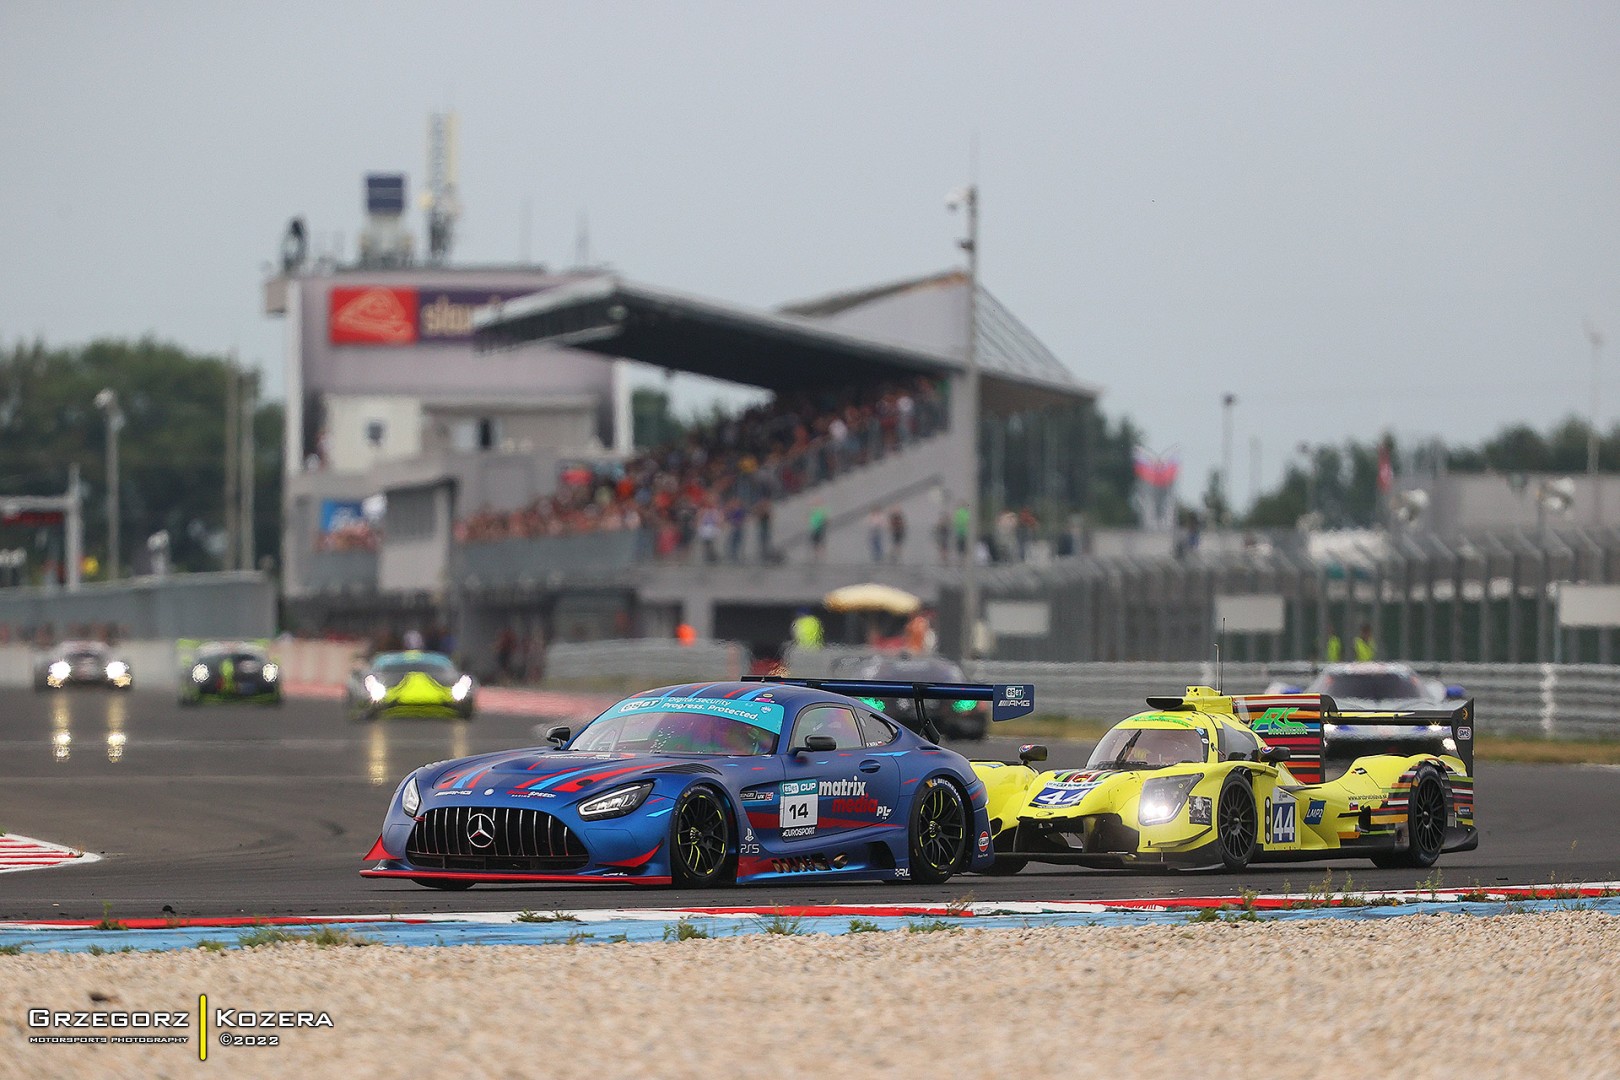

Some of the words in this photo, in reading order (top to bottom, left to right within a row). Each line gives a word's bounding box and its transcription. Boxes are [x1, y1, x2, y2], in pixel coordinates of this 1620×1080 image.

[668, 696, 698, 705] Digital
[698, 697, 731, 707] Security
[661, 701, 705, 710] Progress.
[707, 704, 759, 721] Protected.
[800, 782, 817, 791] CUP
[818, 775, 867, 796] matrix
[831, 793, 879, 813] media
[1037, 788, 1091, 805] 44
[788, 802, 809, 820] 14
[1306, 808, 1324, 818] LMP2
[1273, 805, 1295, 841] 44
[783, 827, 816, 837] EUROSPORT
[740, 843, 760, 854] PS5
